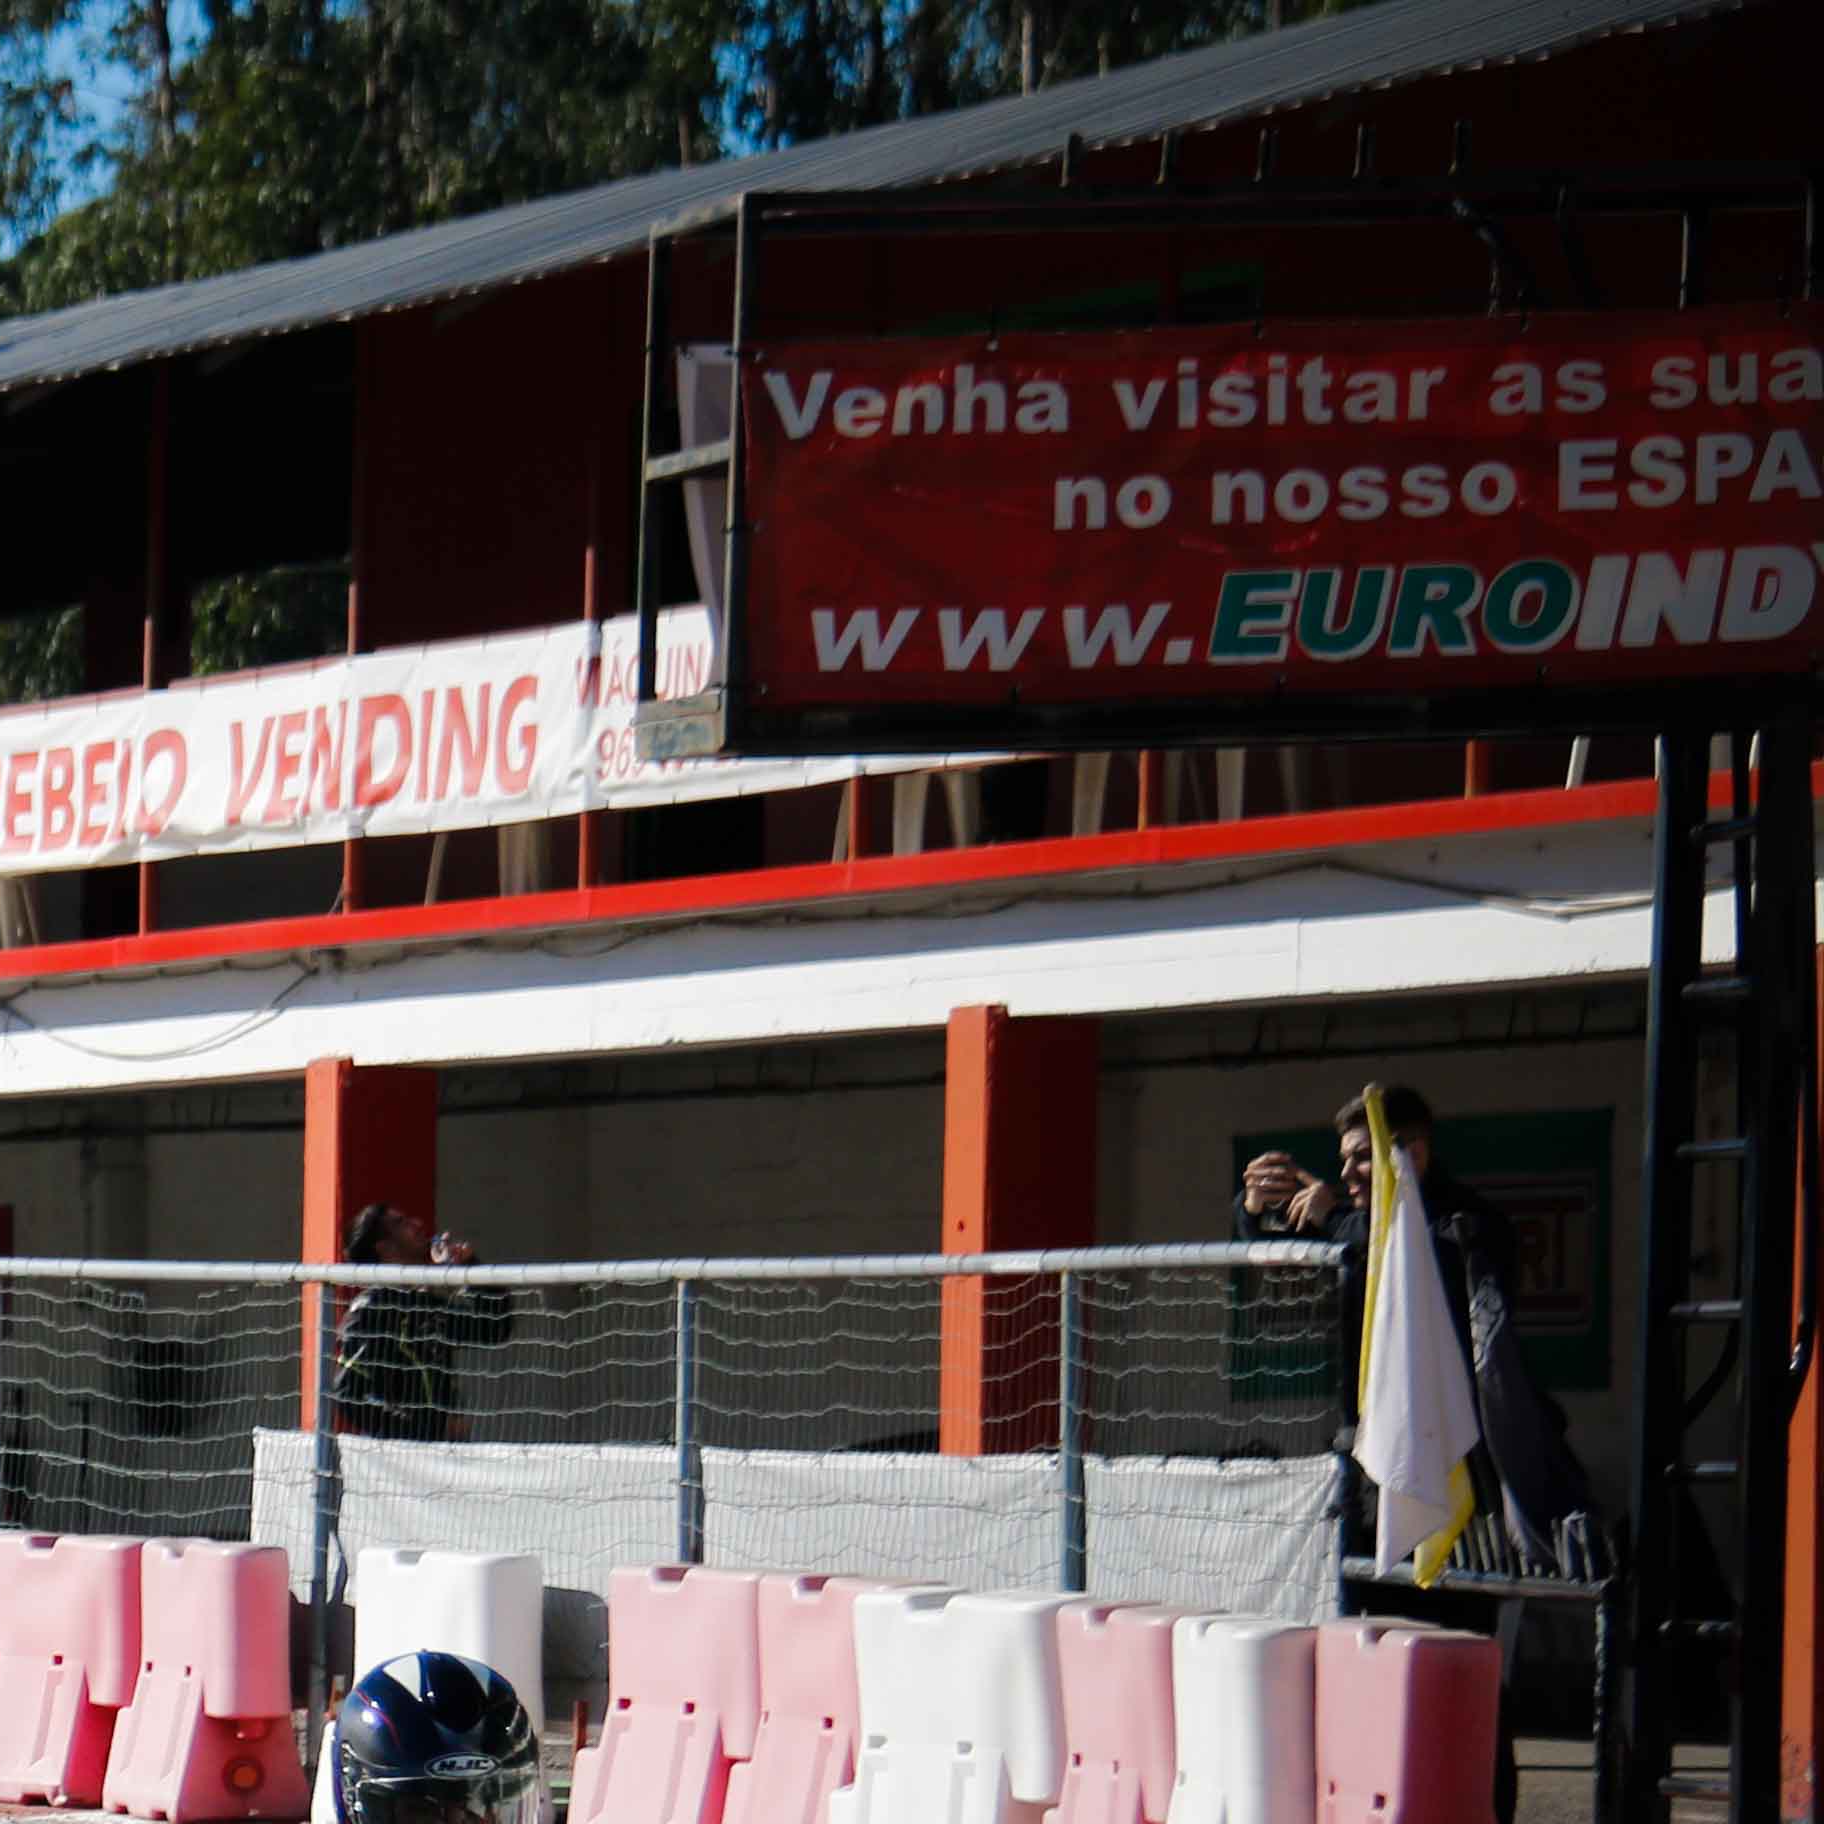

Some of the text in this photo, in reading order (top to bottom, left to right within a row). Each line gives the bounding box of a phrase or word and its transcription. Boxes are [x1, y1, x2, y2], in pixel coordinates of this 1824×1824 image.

[762, 365, 1068, 439] Venha
[1113, 354, 1446, 430] visitar
[1488, 358, 1608, 417] as
[1053, 428, 1824, 531] no nosso ESPA
[810, 546, 1824, 673] www.EUROIND
[227, 673, 540, 829] VENDING
